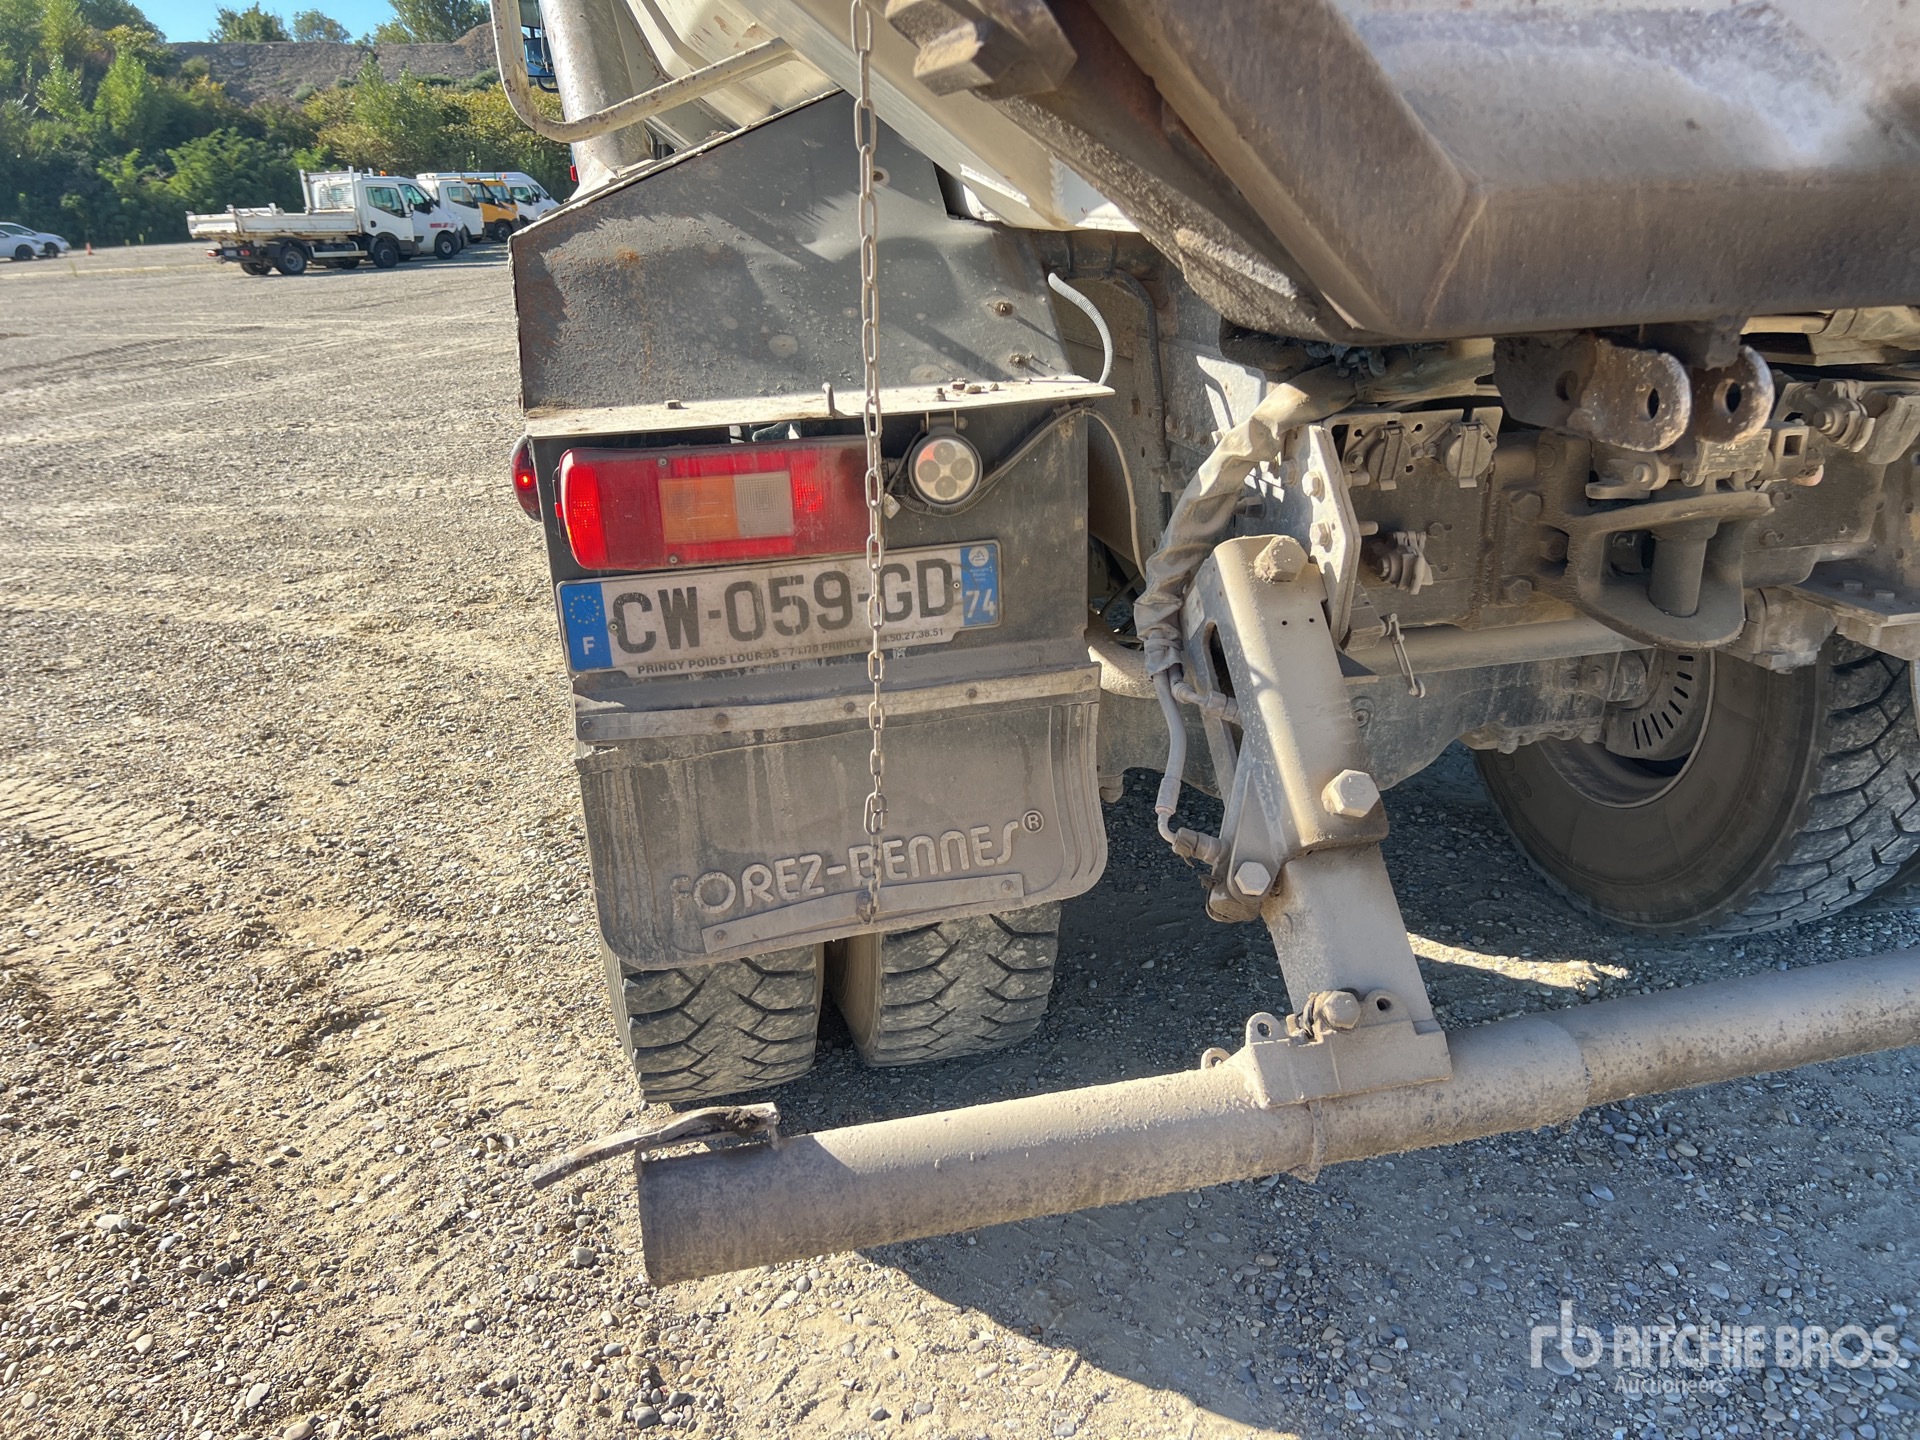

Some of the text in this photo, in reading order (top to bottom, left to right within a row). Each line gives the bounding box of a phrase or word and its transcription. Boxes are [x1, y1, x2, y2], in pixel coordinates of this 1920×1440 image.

[612, 557, 955, 654] CW-059-GD
[965, 588, 996, 619] 74
[582, 636, 596, 656] F
[637, 660, 685, 675] PRINGY
[688, 656, 727, 669] POIDS
[821, 637, 861, 653] PRINGY
[878, 627, 944, 644] 4.50.27.38.51
[669, 819, 1019, 920] FOREZ-BENNES
